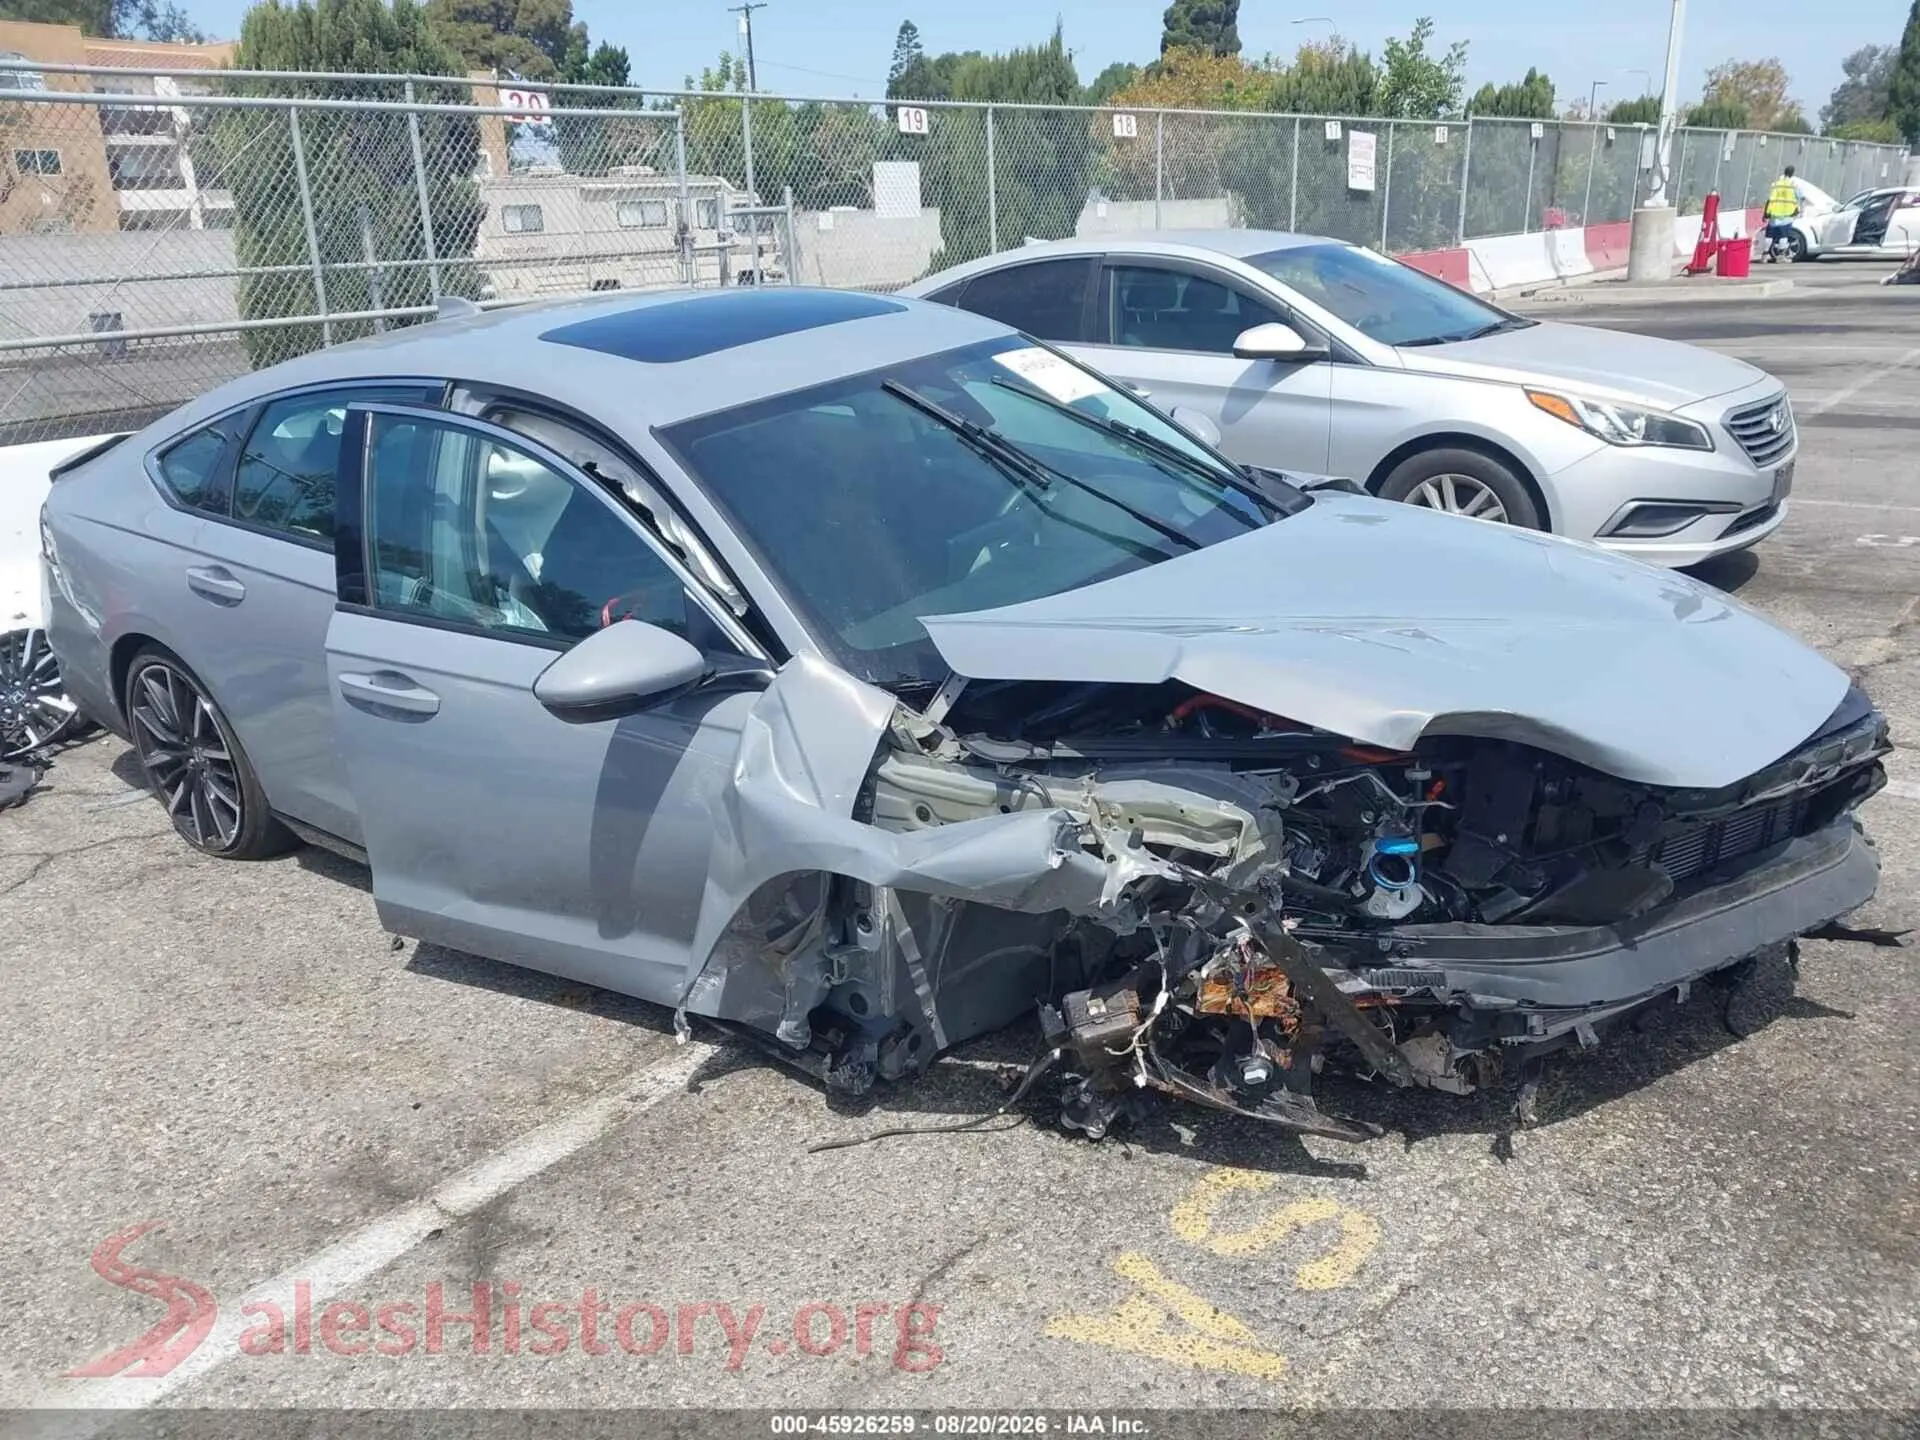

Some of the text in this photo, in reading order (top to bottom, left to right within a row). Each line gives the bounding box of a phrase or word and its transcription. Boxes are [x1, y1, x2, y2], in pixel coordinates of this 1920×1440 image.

[509, 92, 543, 121] 20
[904, 109, 923, 131] 19
[1118, 116, 1133, 134] 18
